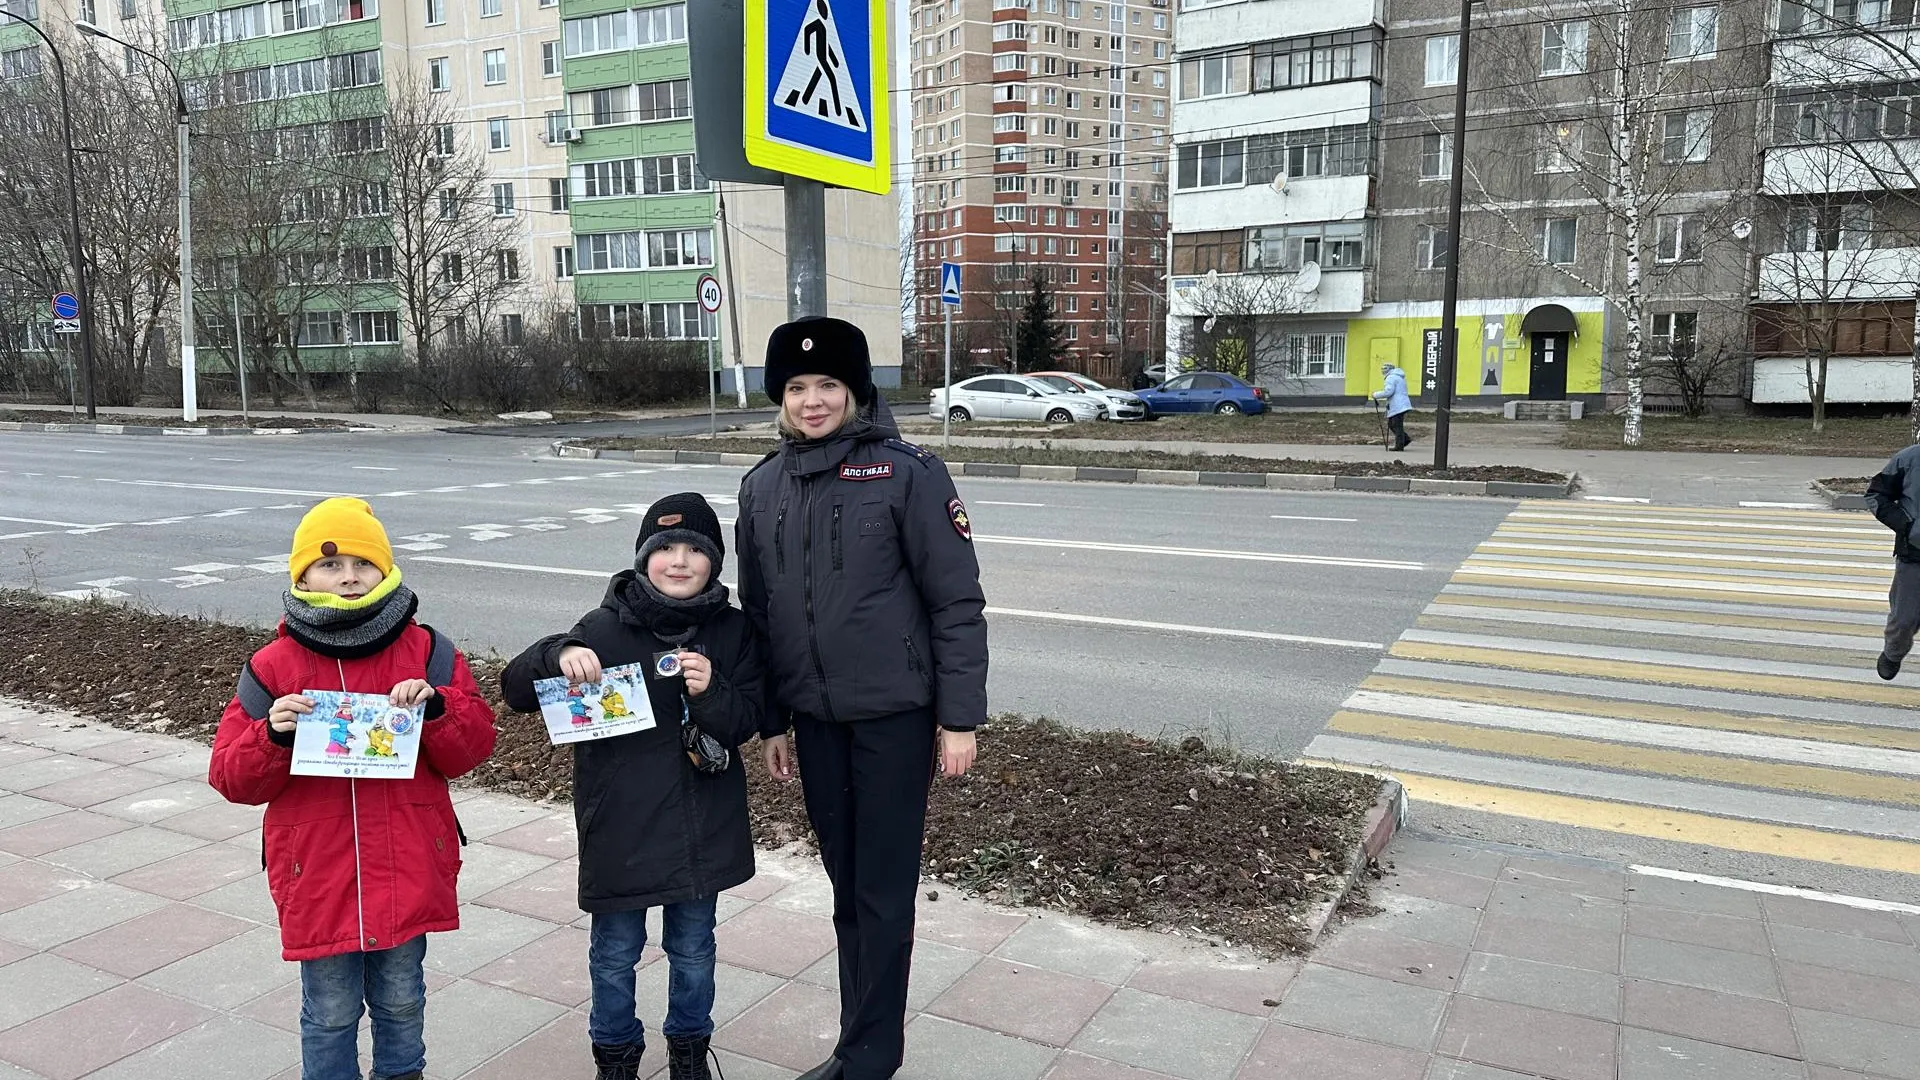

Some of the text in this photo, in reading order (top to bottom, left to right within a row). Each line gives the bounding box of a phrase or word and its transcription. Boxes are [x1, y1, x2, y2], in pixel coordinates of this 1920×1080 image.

[705, 287, 717, 302] 40
[842, 465, 890, 477] ДПС ГИБДД
